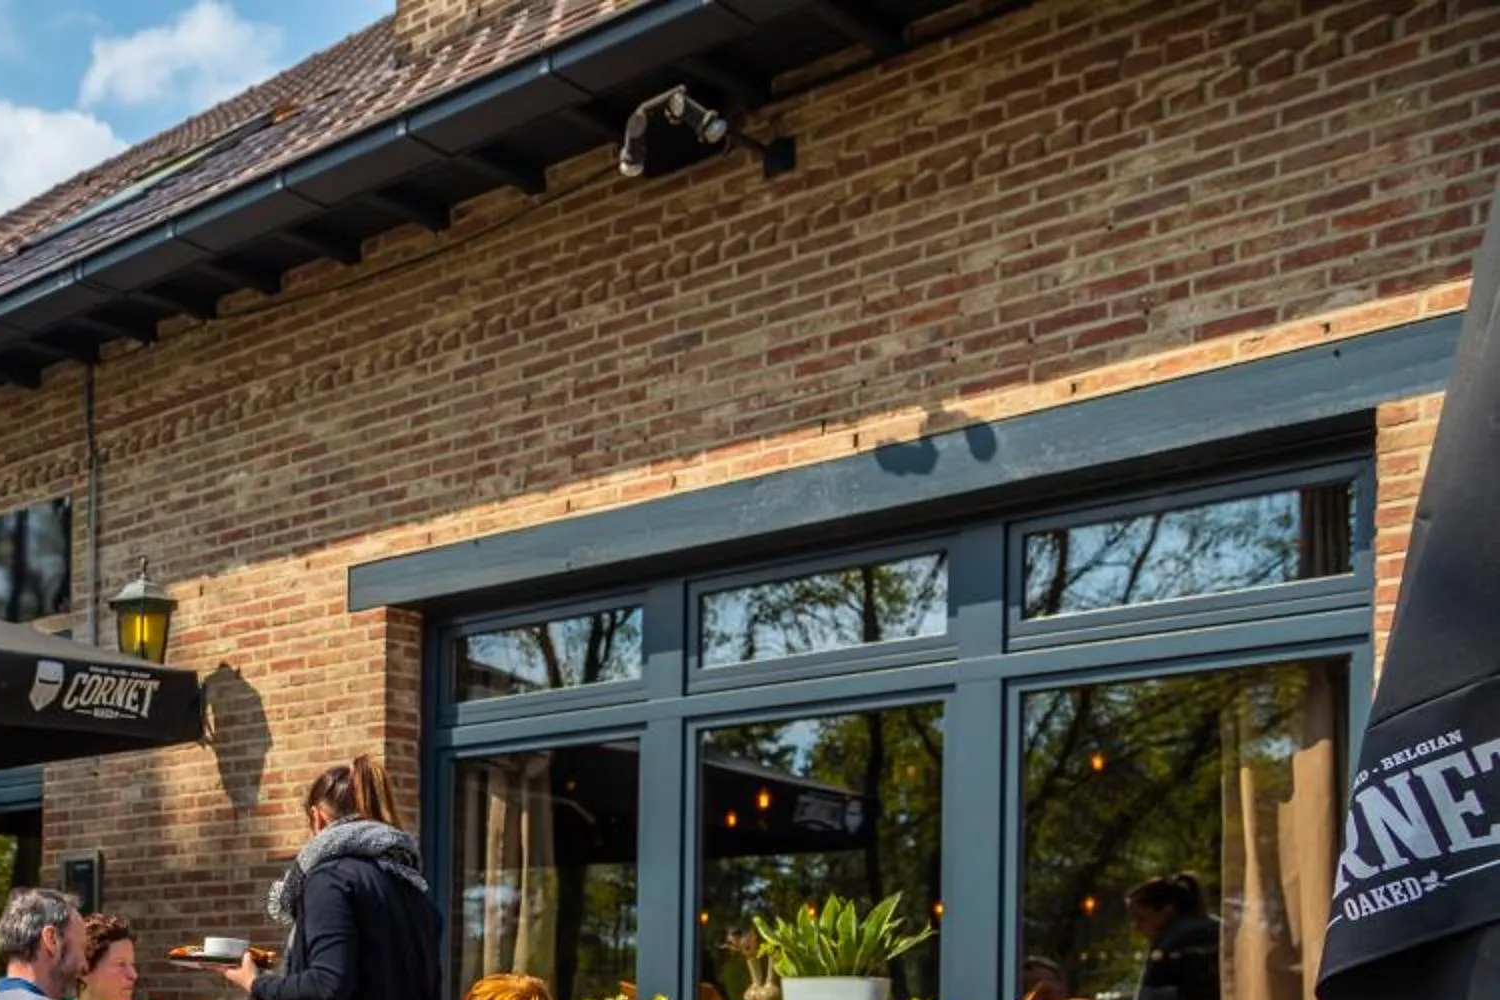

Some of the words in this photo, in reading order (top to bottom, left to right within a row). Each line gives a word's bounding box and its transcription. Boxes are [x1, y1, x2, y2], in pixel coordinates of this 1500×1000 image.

[63, 672, 160, 718] CORNET
[1380, 729, 1463, 772] BELGIAN
[1333, 737, 1500, 899] RNE
[1343, 876, 1423, 921] OAKED
